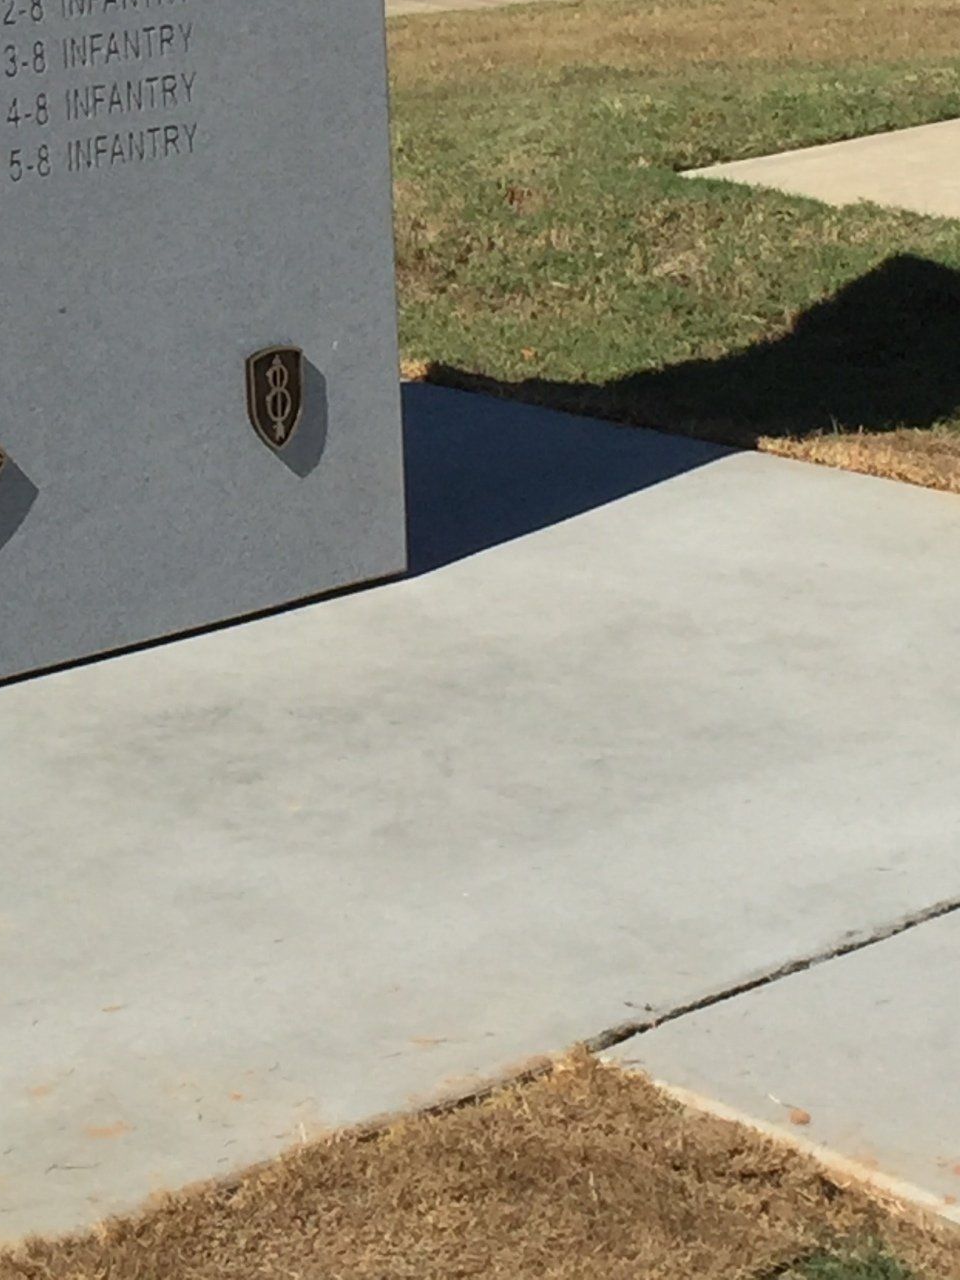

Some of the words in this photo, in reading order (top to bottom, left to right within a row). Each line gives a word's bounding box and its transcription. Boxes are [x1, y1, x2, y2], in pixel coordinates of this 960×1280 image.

[4, 41, 46, 77] 3-8
[62, 23, 194, 69] INFANTRY
[6, 92, 49, 128] 4-8
[66, 72, 197, 120] INFANTRY
[9, 144, 51, 182] 5-8
[67, 122, 199, 172] INFANTRY
